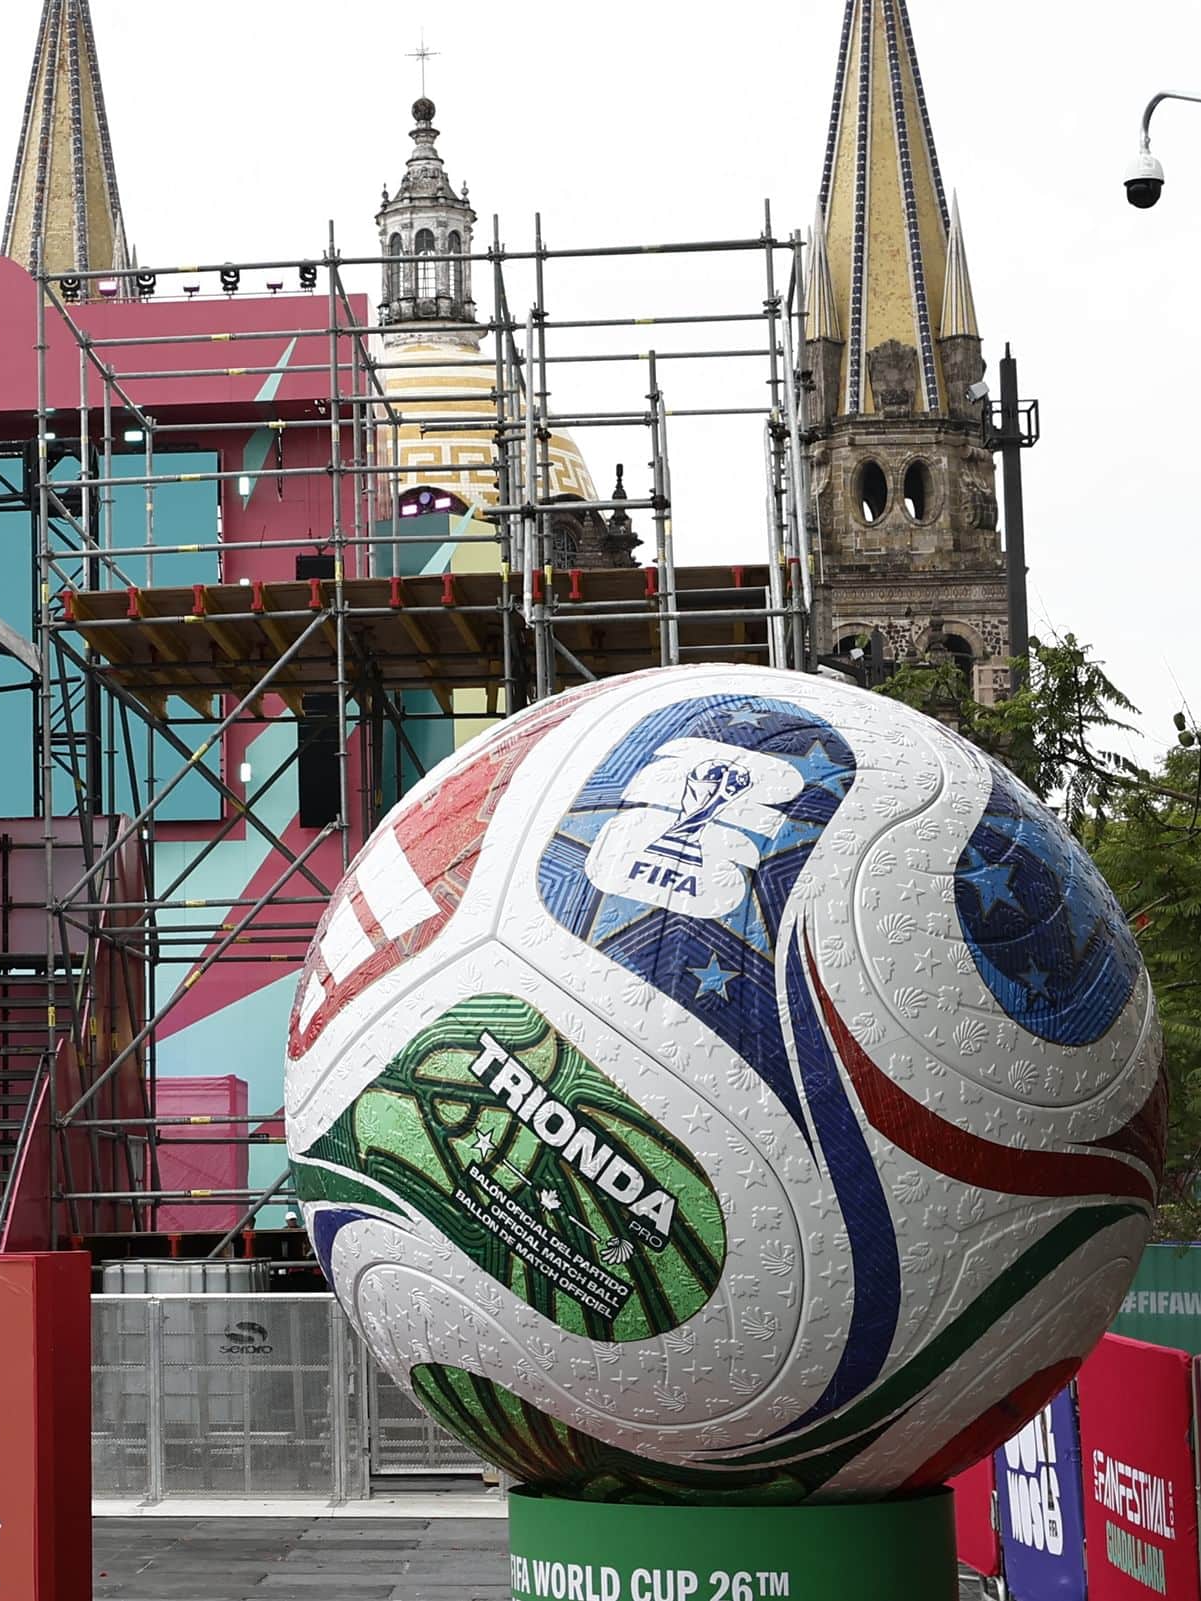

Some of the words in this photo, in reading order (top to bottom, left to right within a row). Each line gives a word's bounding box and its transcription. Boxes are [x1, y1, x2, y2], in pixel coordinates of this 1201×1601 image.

[628, 860, 697, 897] FIFA
[471, 1031, 676, 1237] TRIONDA
[456, 1189, 499, 1232] BALLON
[499, 1230, 517, 1247] DE
[516, 1245, 559, 1281] MATCH
[559, 1279, 613, 1319] OFFICIEL
[469, 1166, 507, 1203] BALÓN
[506, 1197, 549, 1240] OFICIAL
[550, 1236, 571, 1257] DEL
[571, 1255, 629, 1296] PARTIDO
[491, 1204, 540, 1251] OFFICIAL
[541, 1247, 586, 1285] MATCH
[587, 1281, 620, 1308] BALL
[629, 1220, 663, 1248] PRO
[532, 1559, 621, 1601] WORLD
[630, 1567, 698, 1601] CUP
